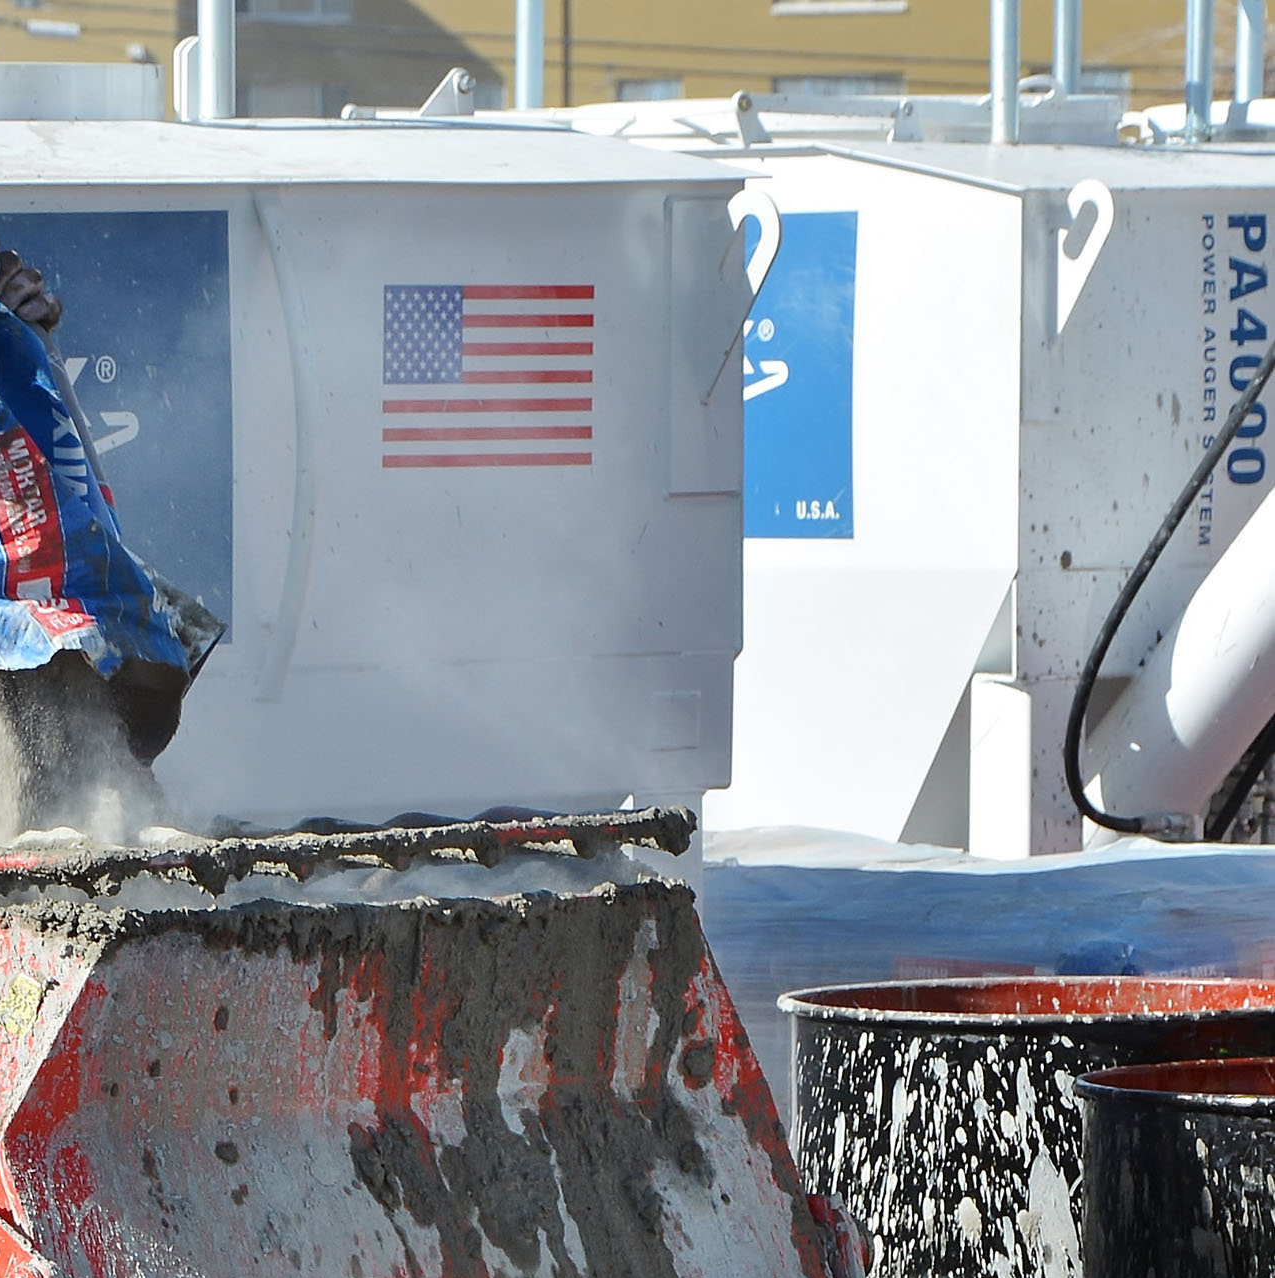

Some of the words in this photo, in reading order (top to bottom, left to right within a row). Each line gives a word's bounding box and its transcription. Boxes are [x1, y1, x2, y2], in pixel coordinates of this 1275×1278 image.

[1202, 214, 1217, 315] POWER
[1202, 327, 1217, 422] AUGER
[1227, 213, 1269, 485] PA4000
[795, 500, 841, 520] U.S.A.
